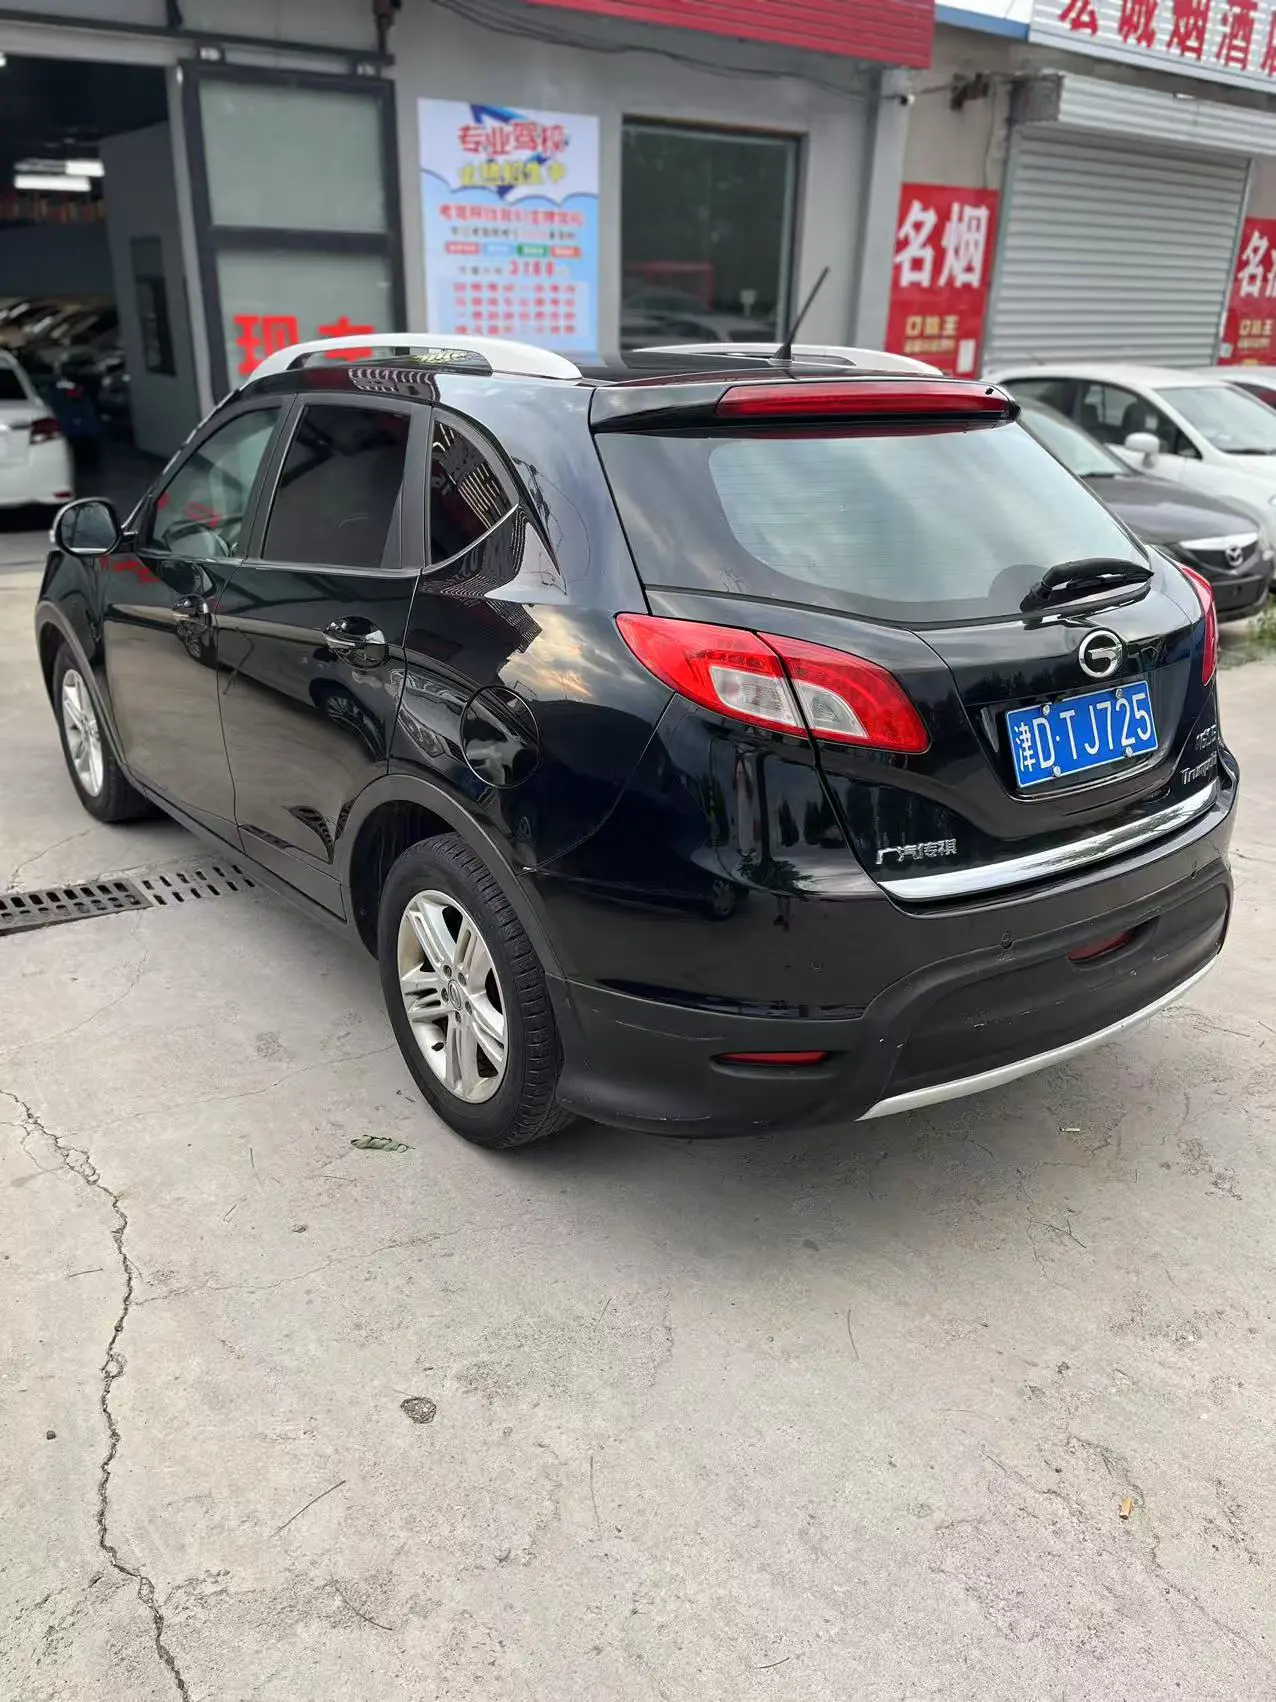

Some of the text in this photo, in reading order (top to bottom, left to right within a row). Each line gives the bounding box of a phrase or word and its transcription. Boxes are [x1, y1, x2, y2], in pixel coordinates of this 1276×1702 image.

[458, 121, 566, 156] 专业驾校
[893, 198, 989, 289] 名烟
[875, 838, 957, 865] 广汽传祺
